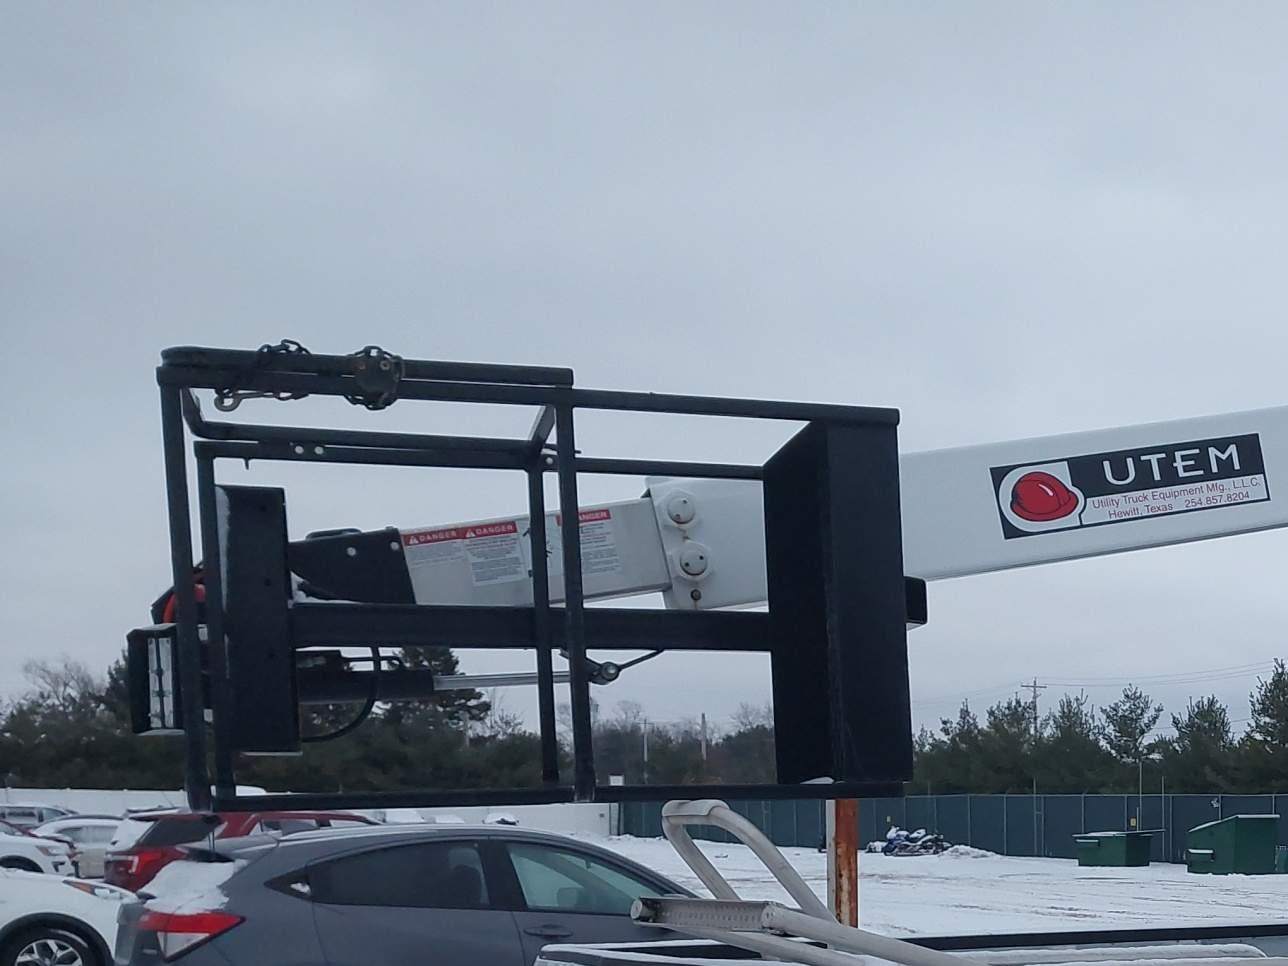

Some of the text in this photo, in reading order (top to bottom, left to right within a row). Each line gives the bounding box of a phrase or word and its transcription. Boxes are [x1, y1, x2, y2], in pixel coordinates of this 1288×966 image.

[1102, 444, 1241, 486] UTEM
[1092, 498, 1120, 510] Utility
[1122, 493, 1149, 505] Truck
[1151, 485, 1204, 502] Equipment
[1108, 491, 1250, 519] Hewitt, Texas 254.857.8204
[419, 530, 457, 542] DANGER
[475, 524, 514, 536] DANGER
